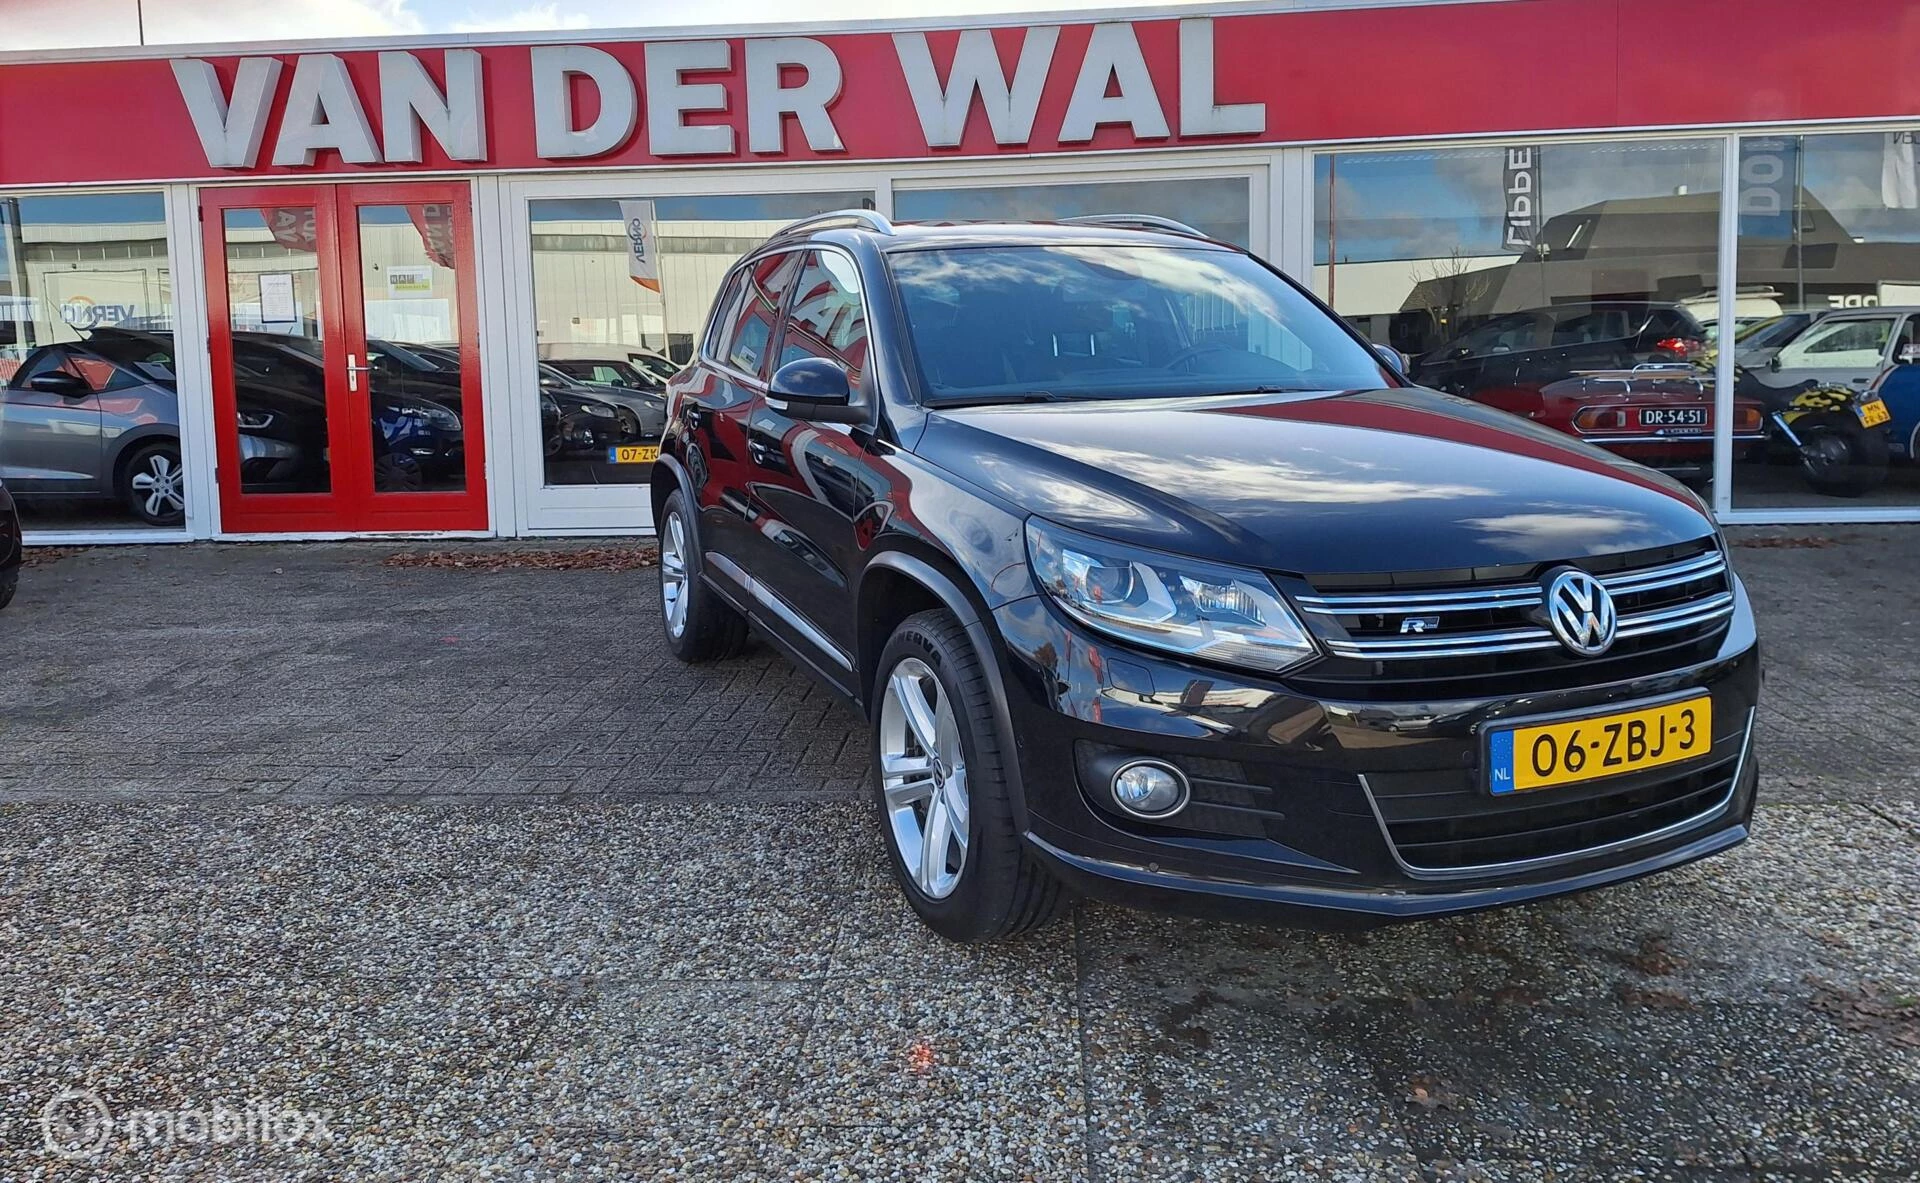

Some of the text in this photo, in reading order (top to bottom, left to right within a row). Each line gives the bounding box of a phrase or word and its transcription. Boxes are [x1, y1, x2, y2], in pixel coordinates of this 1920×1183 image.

[169, 19, 1266, 169] VAN DER WAL
[1646, 410, 1701, 424] DR-54-51
[1531, 709, 1695, 777] 06-ZBJ-3
[1494, 767, 1511, 781] NL
